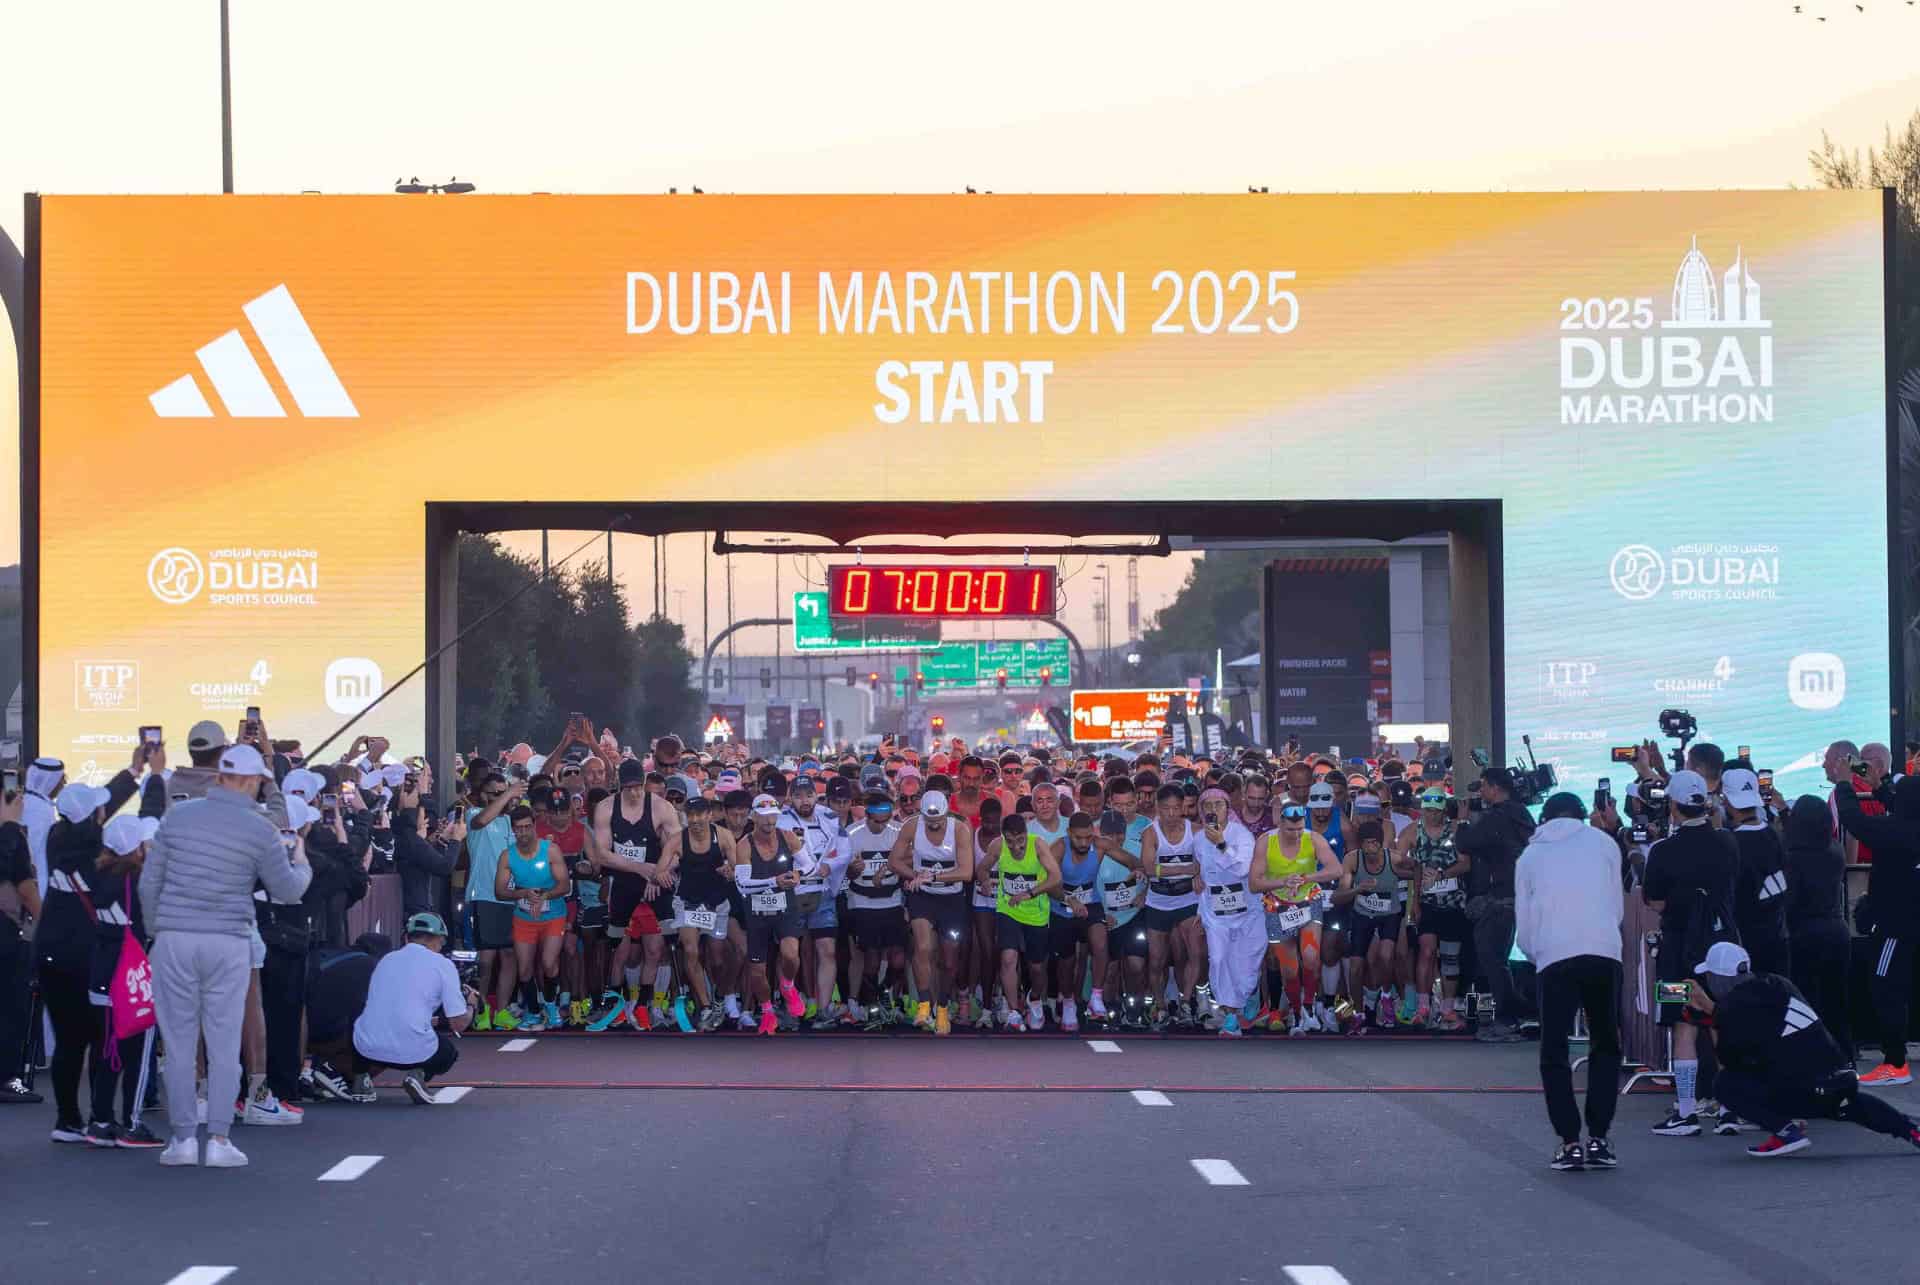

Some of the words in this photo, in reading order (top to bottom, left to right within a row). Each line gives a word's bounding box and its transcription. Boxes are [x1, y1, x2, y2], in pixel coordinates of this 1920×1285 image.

[626, 271, 790, 335] DUBAI
[817, 271, 1126, 335] MARATHON
[1151, 269, 1299, 334] 2025
[1560, 297, 1653, 329] 2025
[1560, 335, 1773, 389] DUBAI
[874, 359, 1053, 423] START
[1560, 393, 1773, 424] MARATHON
[209, 562, 318, 589] DUBAI
[1672, 558, 1779, 584] DUBAI
[209, 594, 259, 605] SPORTS
[263, 594, 318, 604] COUNCIL
[1672, 589, 1721, 600] SPORTS
[83, 665, 134, 688] ITP
[190, 683, 261, 696] CHANNEL
[250, 659, 272, 685] 4
[1546, 662, 1597, 687] ITP
[1654, 679, 1724, 691] CHANNEL
[1712, 656, 1736, 681] 4
[1279, 687, 1307, 697] WATER
[760, 896, 778, 905] 586
